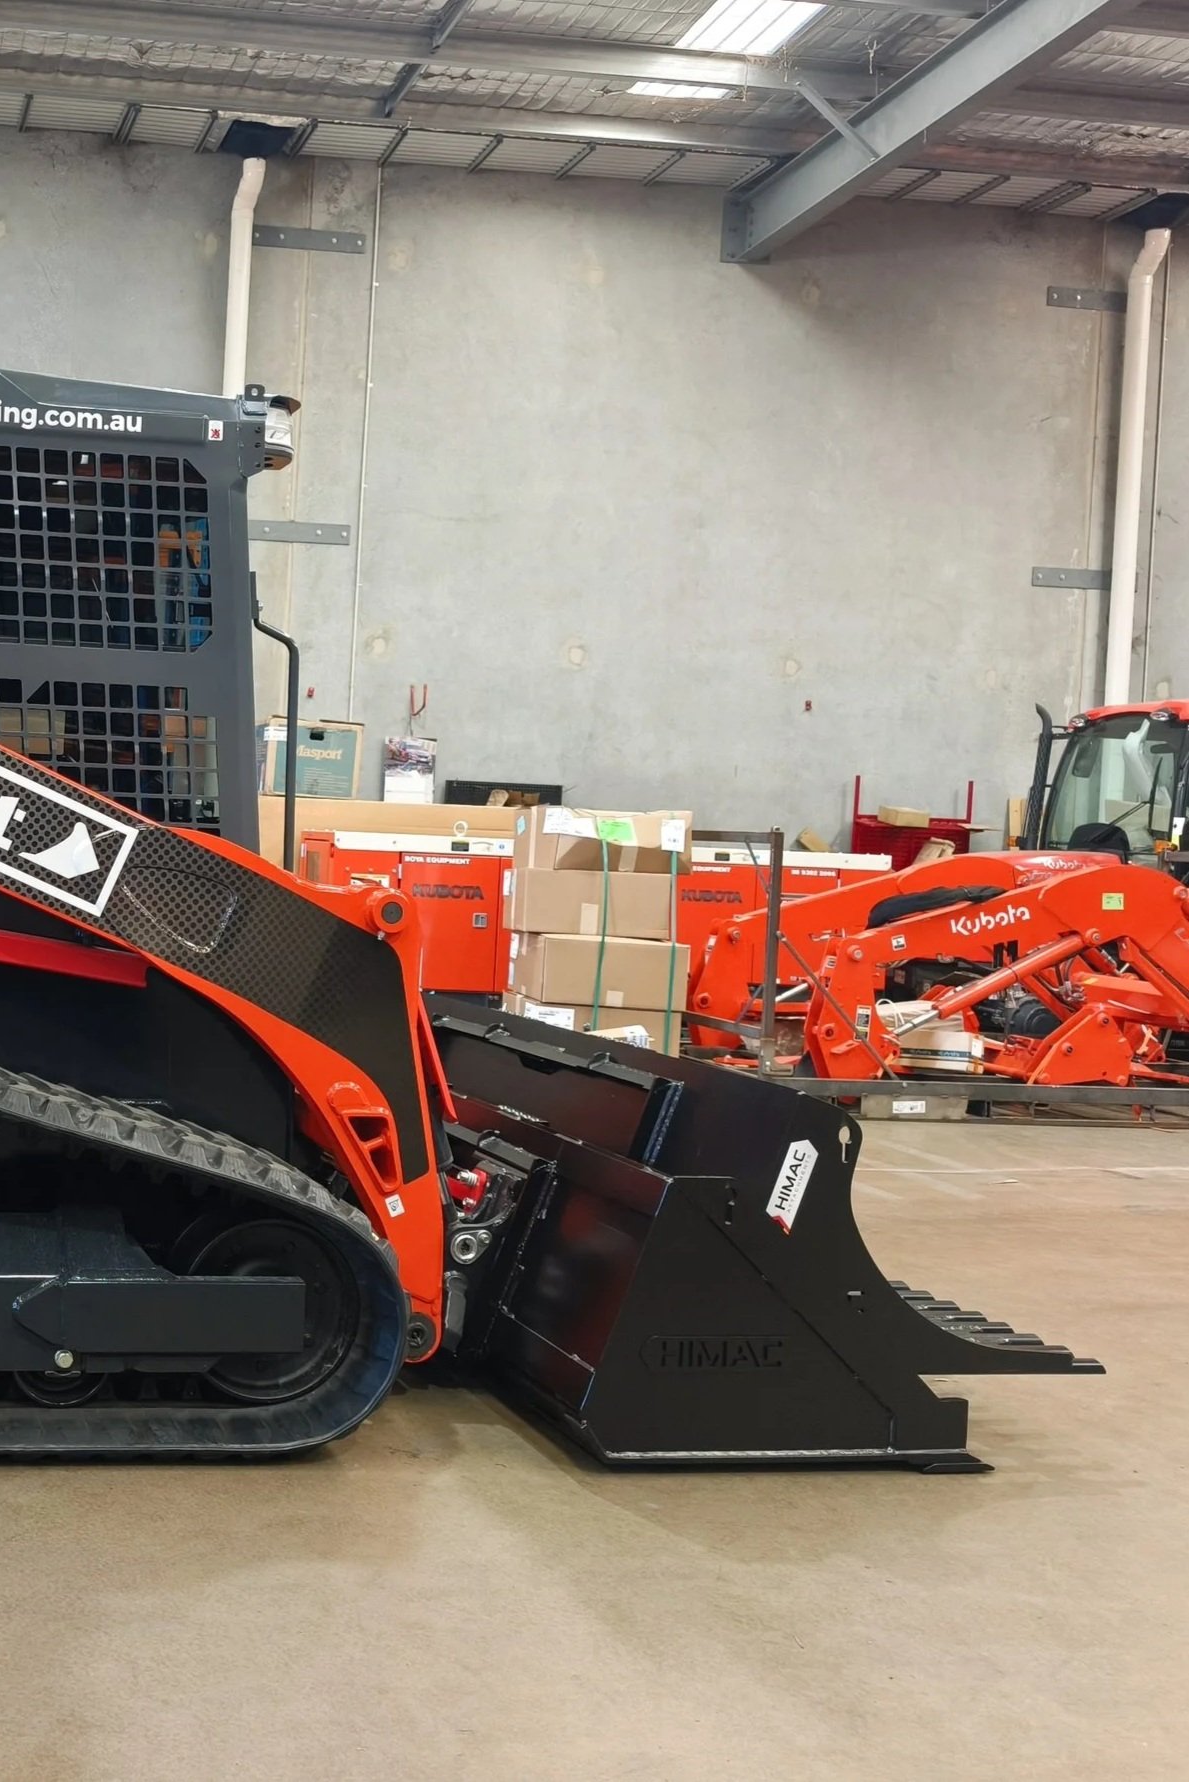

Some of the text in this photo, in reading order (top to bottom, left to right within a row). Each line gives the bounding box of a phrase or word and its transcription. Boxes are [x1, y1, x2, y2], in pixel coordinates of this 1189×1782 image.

[426, 856, 471, 865] EQUIPMENT
[412, 882, 485, 900] KUBOTA
[681, 888, 742, 903] KUBOTA
[950, 904, 1031, 935] Kubota
[775, 1149, 806, 1211] HIMAC
[661, 1341, 783, 1367] HIMAC
